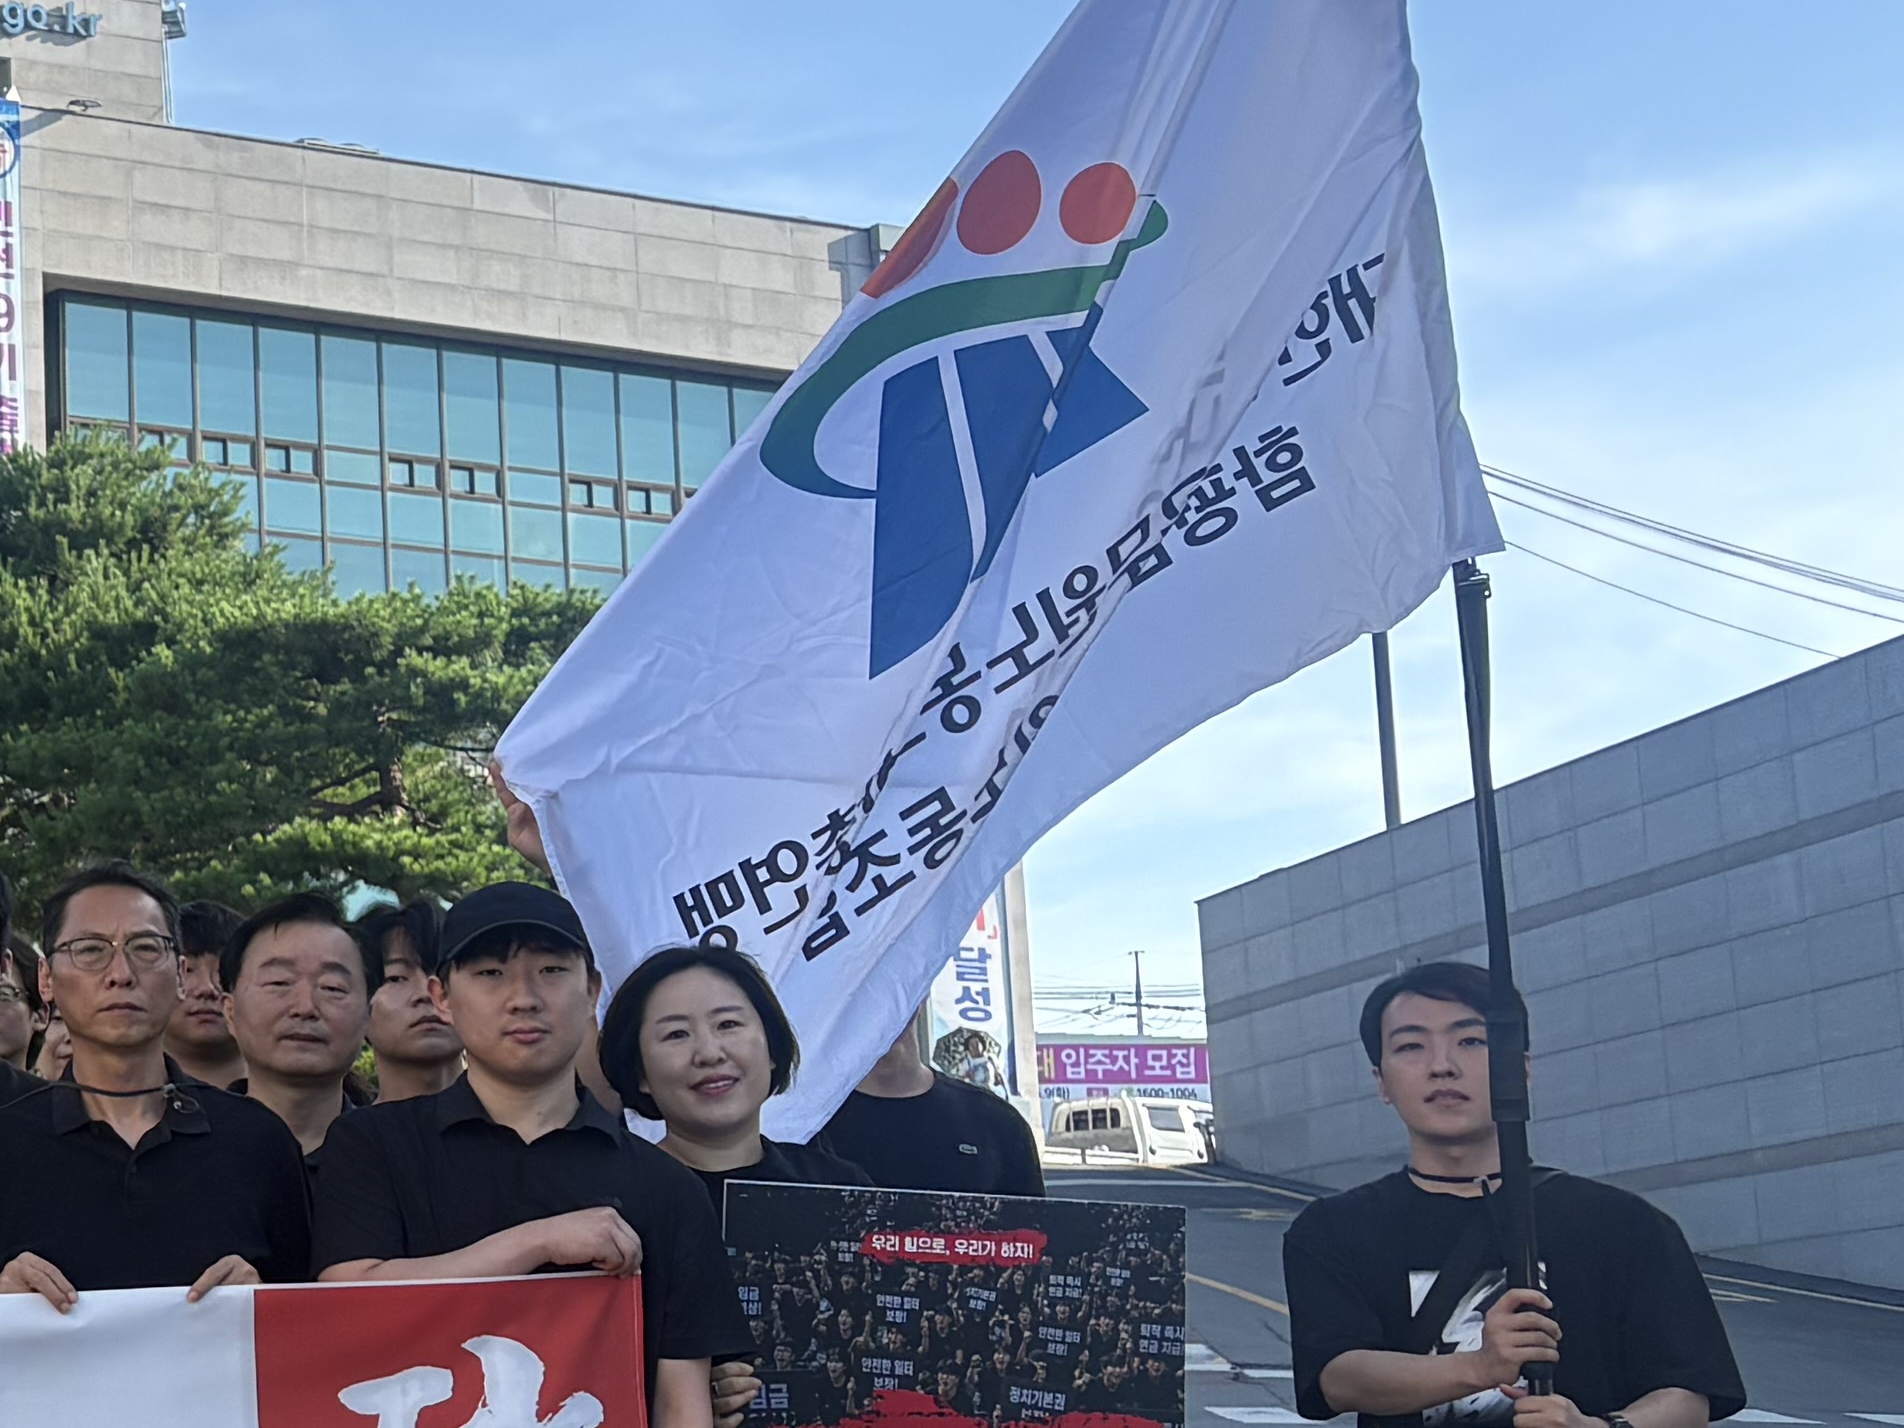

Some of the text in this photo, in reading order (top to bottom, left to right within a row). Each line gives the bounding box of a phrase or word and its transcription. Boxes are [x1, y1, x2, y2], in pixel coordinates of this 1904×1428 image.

[1060, 1046, 1140, 1080] 입주자
[1144, 1046, 1197, 1080] 모집
[871, 1234, 900, 1252] 우리
[904, 1236, 950, 1256] 힘으로,
[954, 1239, 996, 1257] 우리가
[1000, 1241, 1033, 1259] 하자!
